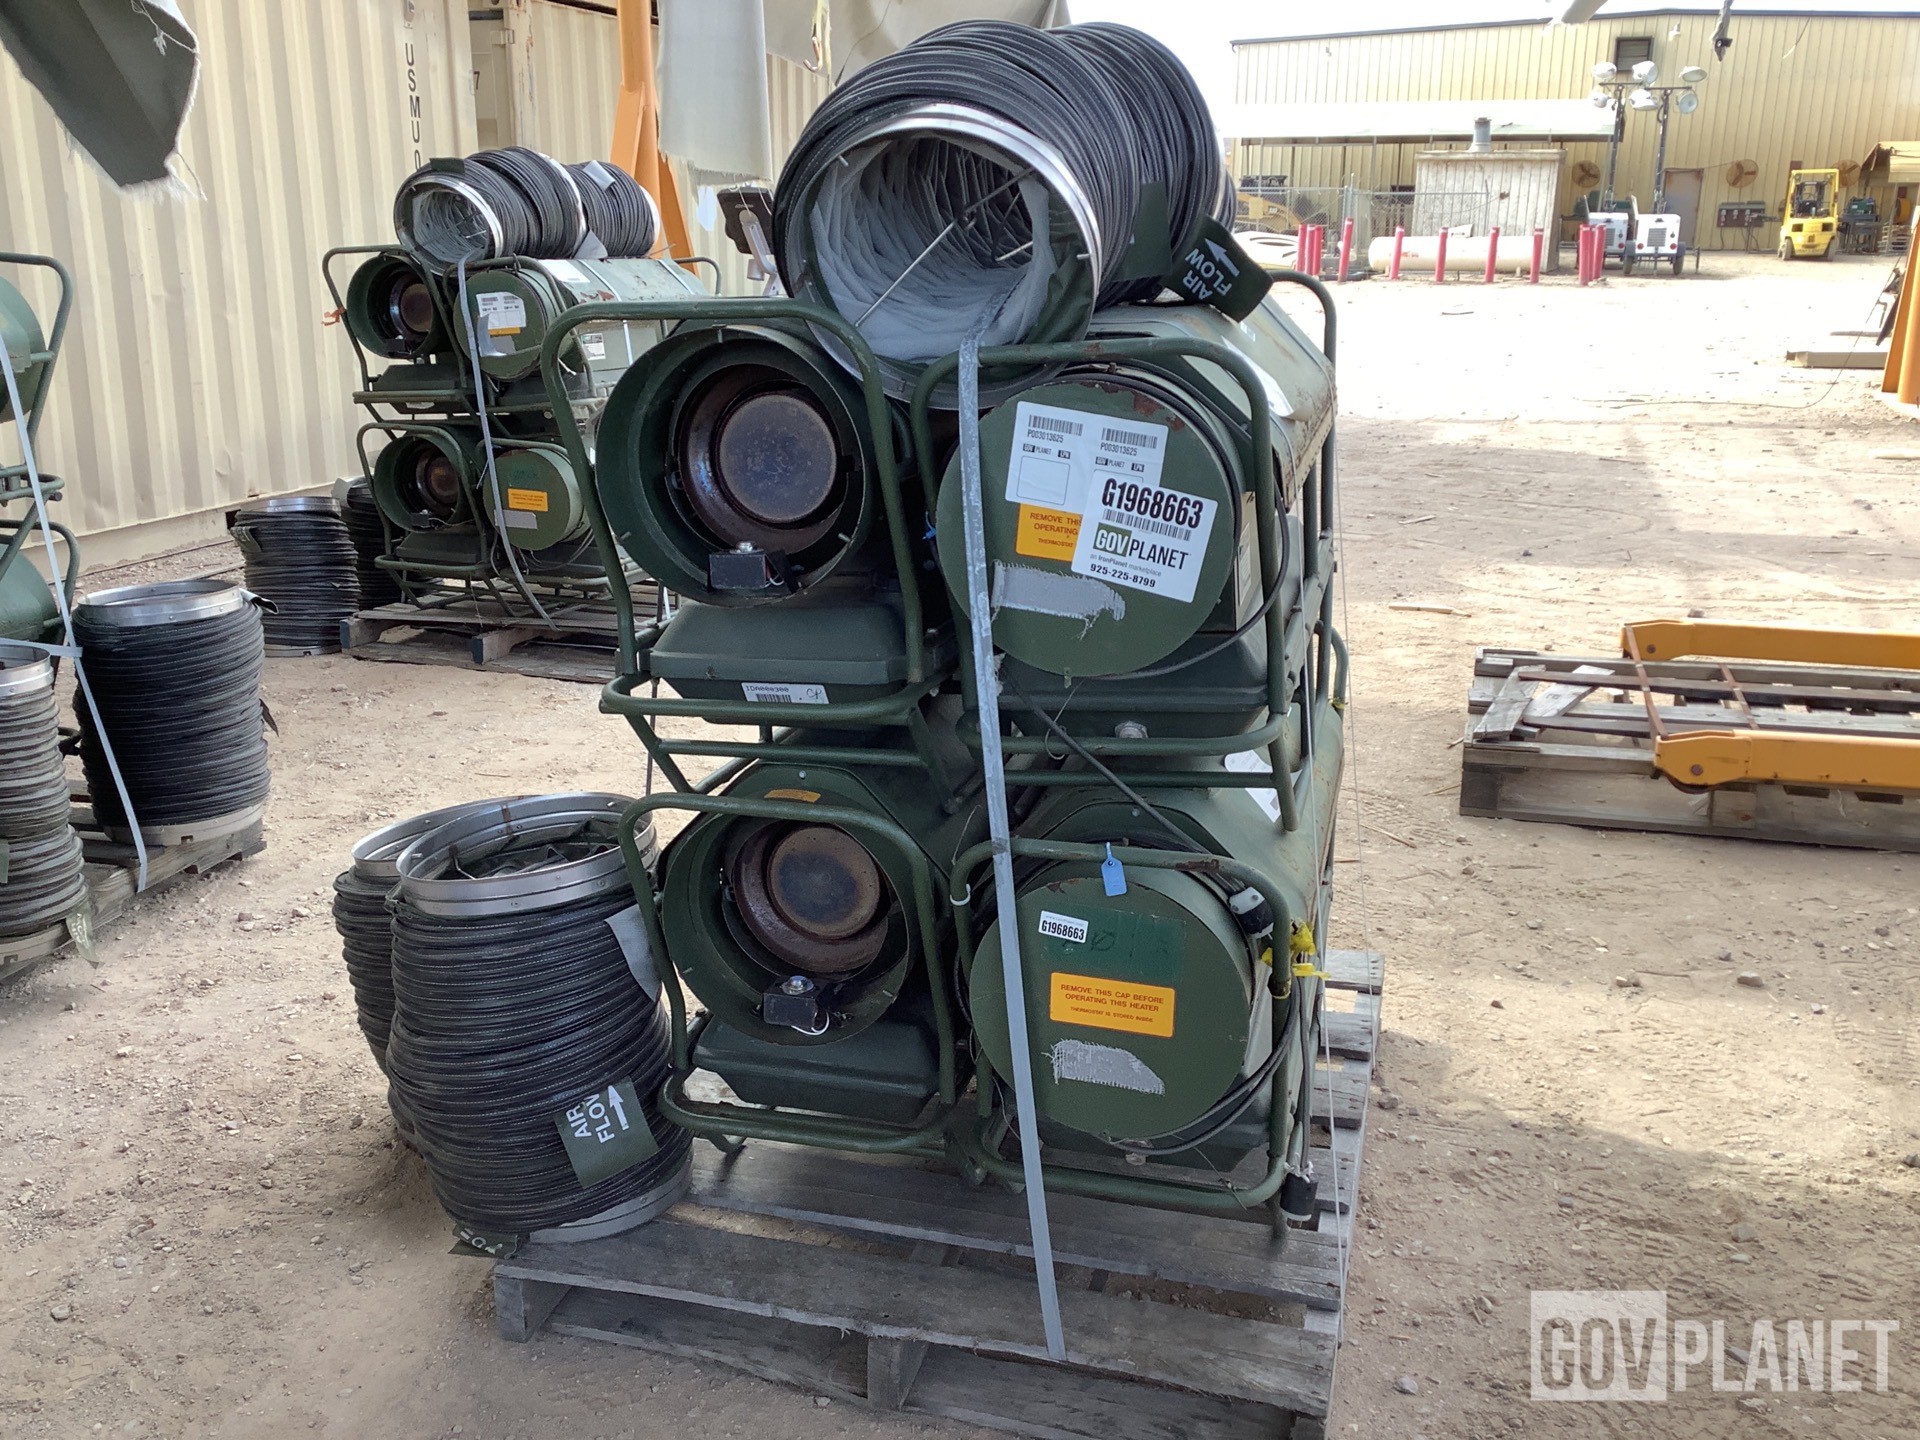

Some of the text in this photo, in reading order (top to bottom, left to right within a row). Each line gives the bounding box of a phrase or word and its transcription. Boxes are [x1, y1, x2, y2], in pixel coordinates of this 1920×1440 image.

[404, 42, 422, 144] USMU
[1185, 248, 1232, 295] FLOW
[1183, 271, 1213, 299] AIR
[1027, 429, 1064, 443] P003013625
[1100, 442, 1138, 456] P003013625
[1101, 478, 1204, 529] G1968663
[1030, 512, 1063, 525] REMOVE
[1034, 523, 1078, 536] OPERATING
[1038, 538, 1074, 548] THERMOSTAT
[1090, 563, 1156, 588] 925-225-8799
[1098, 555, 1128, 568] IronPlanet
[1128, 563, 1162, 577] marketplace
[1041, 920, 1085, 941] G1968663
[1060, 984, 1164, 1004] REMOVE THIS CAP BEFORE
[1065, 993, 1159, 1012] OPERATING THIS HEATER
[1070, 1006, 1104, 1016] THERMOSTAT
[1112, 1012, 1134, 1020] STORED
[565, 1104, 592, 1138] AIR
